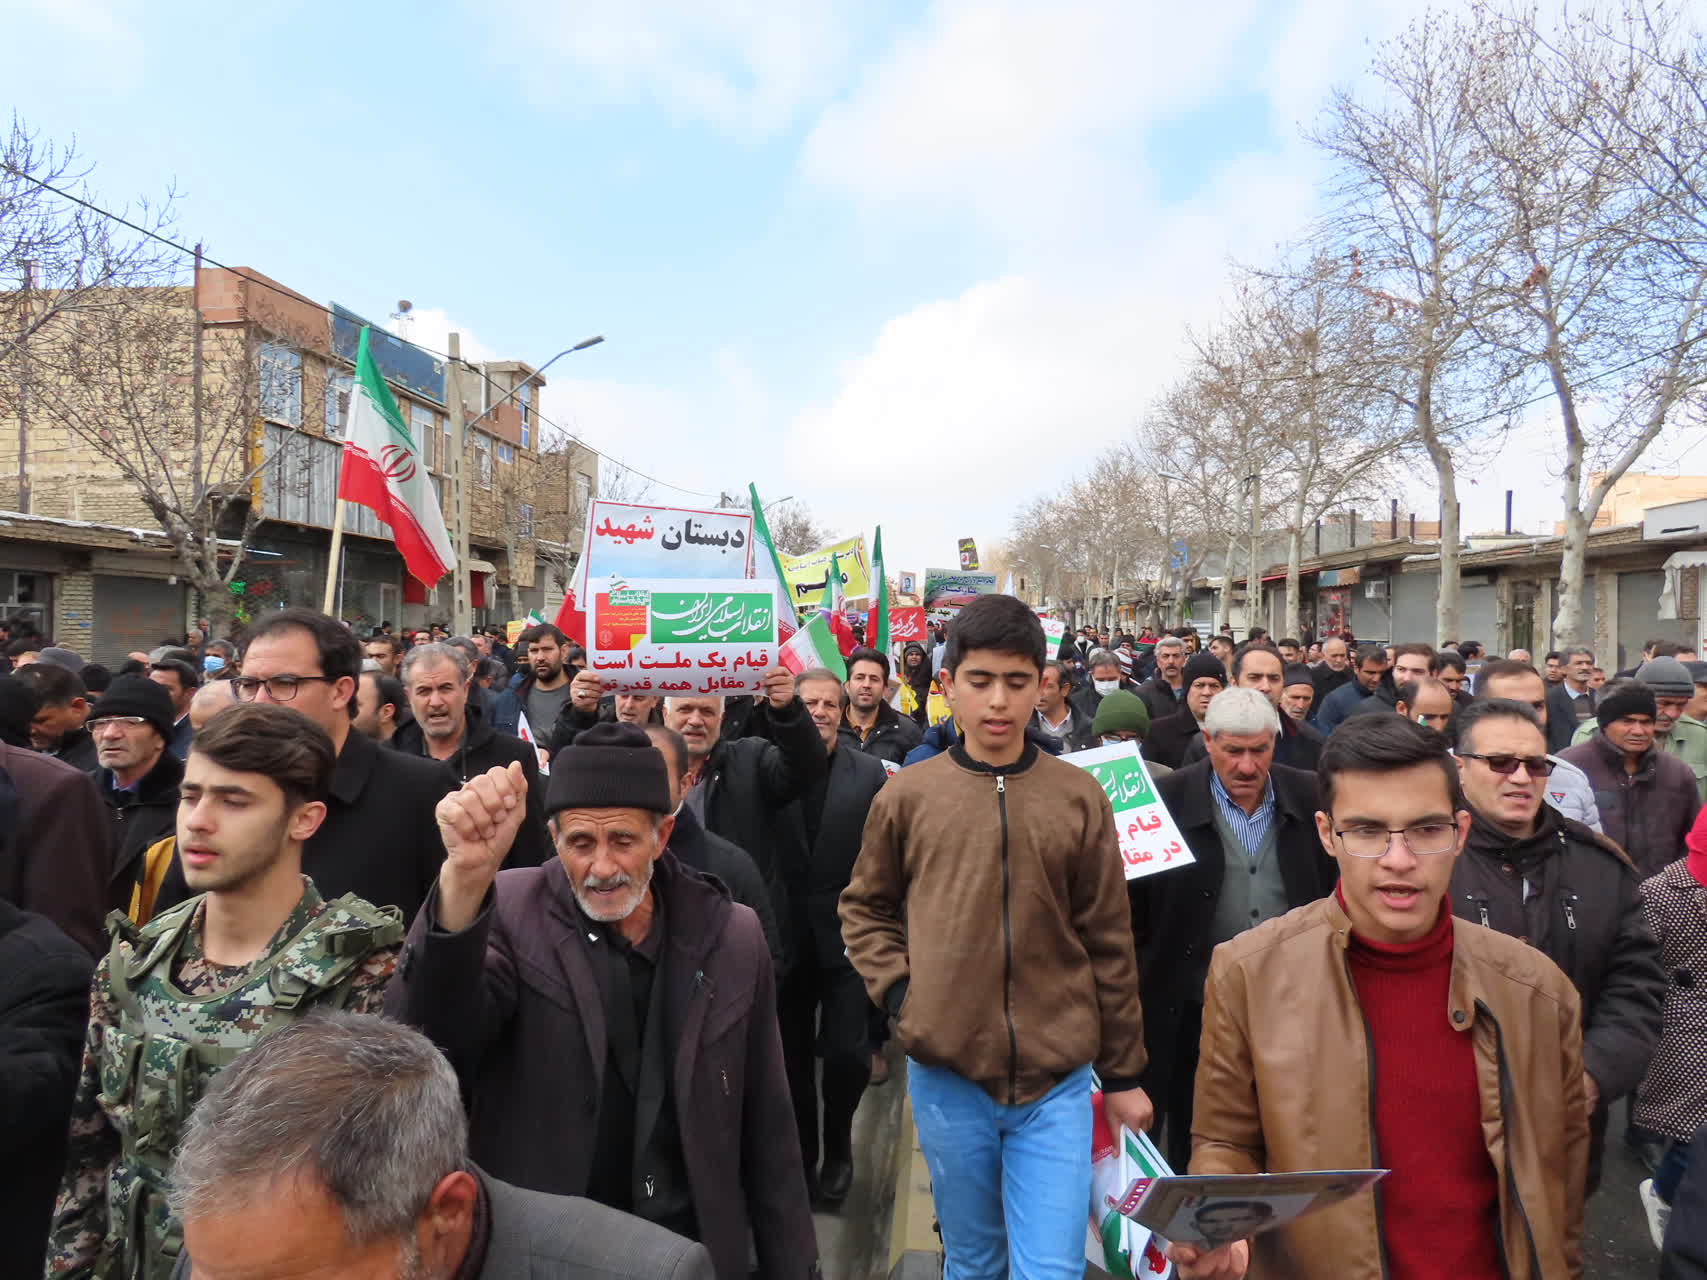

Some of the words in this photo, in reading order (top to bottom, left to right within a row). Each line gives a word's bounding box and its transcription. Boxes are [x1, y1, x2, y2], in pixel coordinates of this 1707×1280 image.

[595, 515, 655, 544] شهید
[661, 518, 745, 554] دبستان
[796, 568, 848, 598] ملم
[651, 592, 713, 624] ایران
[672, 596, 745, 641] اسلامی
[708, 607, 771, 642] انقلاب
[592, 652, 633, 670] است
[697, 651, 727, 672] یک
[733, 649, 769, 673] قیام
[657, 679, 692, 691] همه
[698, 676, 745, 693] مقابل
[751, 680, 762, 691] ر
[1127, 810, 1162, 841] قیام
[1163, 840, 1182, 862] در
